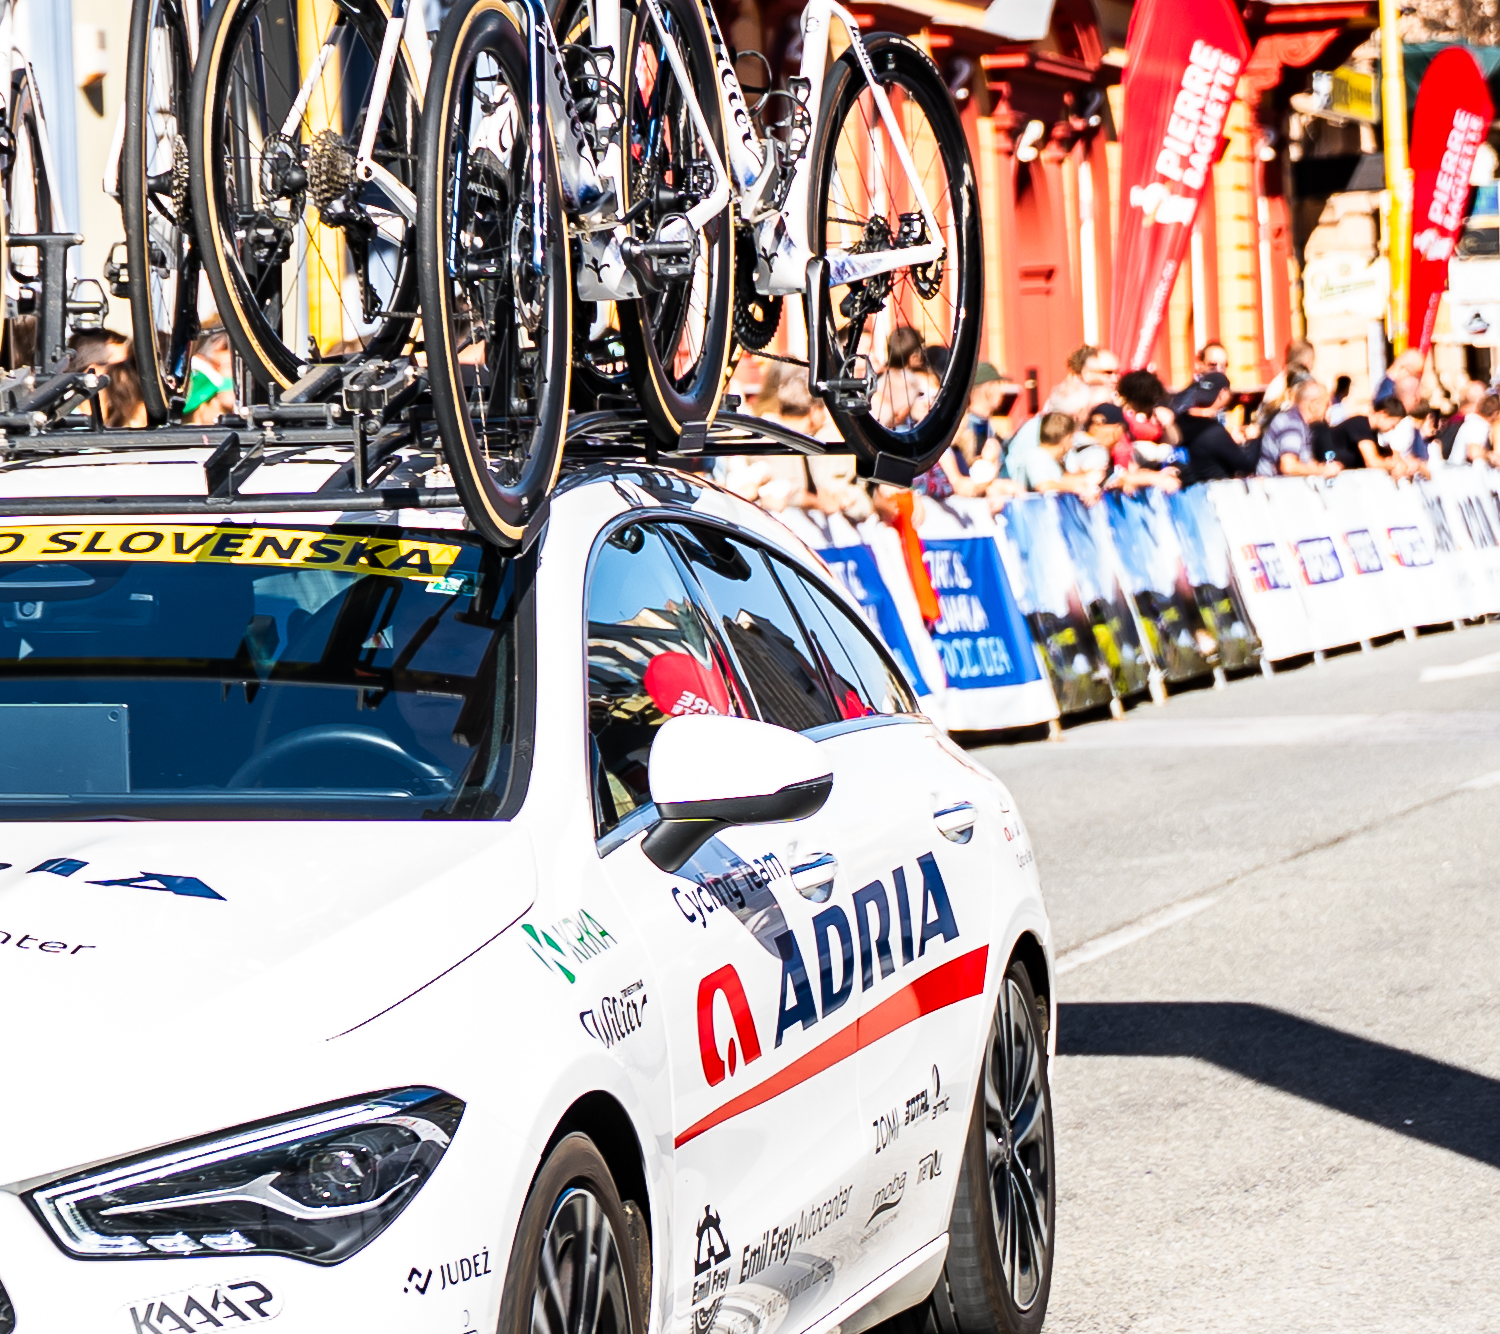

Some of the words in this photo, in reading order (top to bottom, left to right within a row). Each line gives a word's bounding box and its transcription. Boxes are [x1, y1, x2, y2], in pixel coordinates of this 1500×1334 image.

[1155, 39, 1221, 182] PIERRE
[1427, 108, 1473, 226] PIERRE
[40, 529, 435, 575] SLOVENSKA
[671, 871, 747, 929] Cycling
[741, 852, 787, 893] Team
[773, 851, 961, 1051] ADRIA
[739, 1229, 771, 1285] Emil
[767, 1222, 797, 1267] Frey
[794, 1184, 853, 1250] Avtocenter
[691, 1270, 712, 1307] Emil
